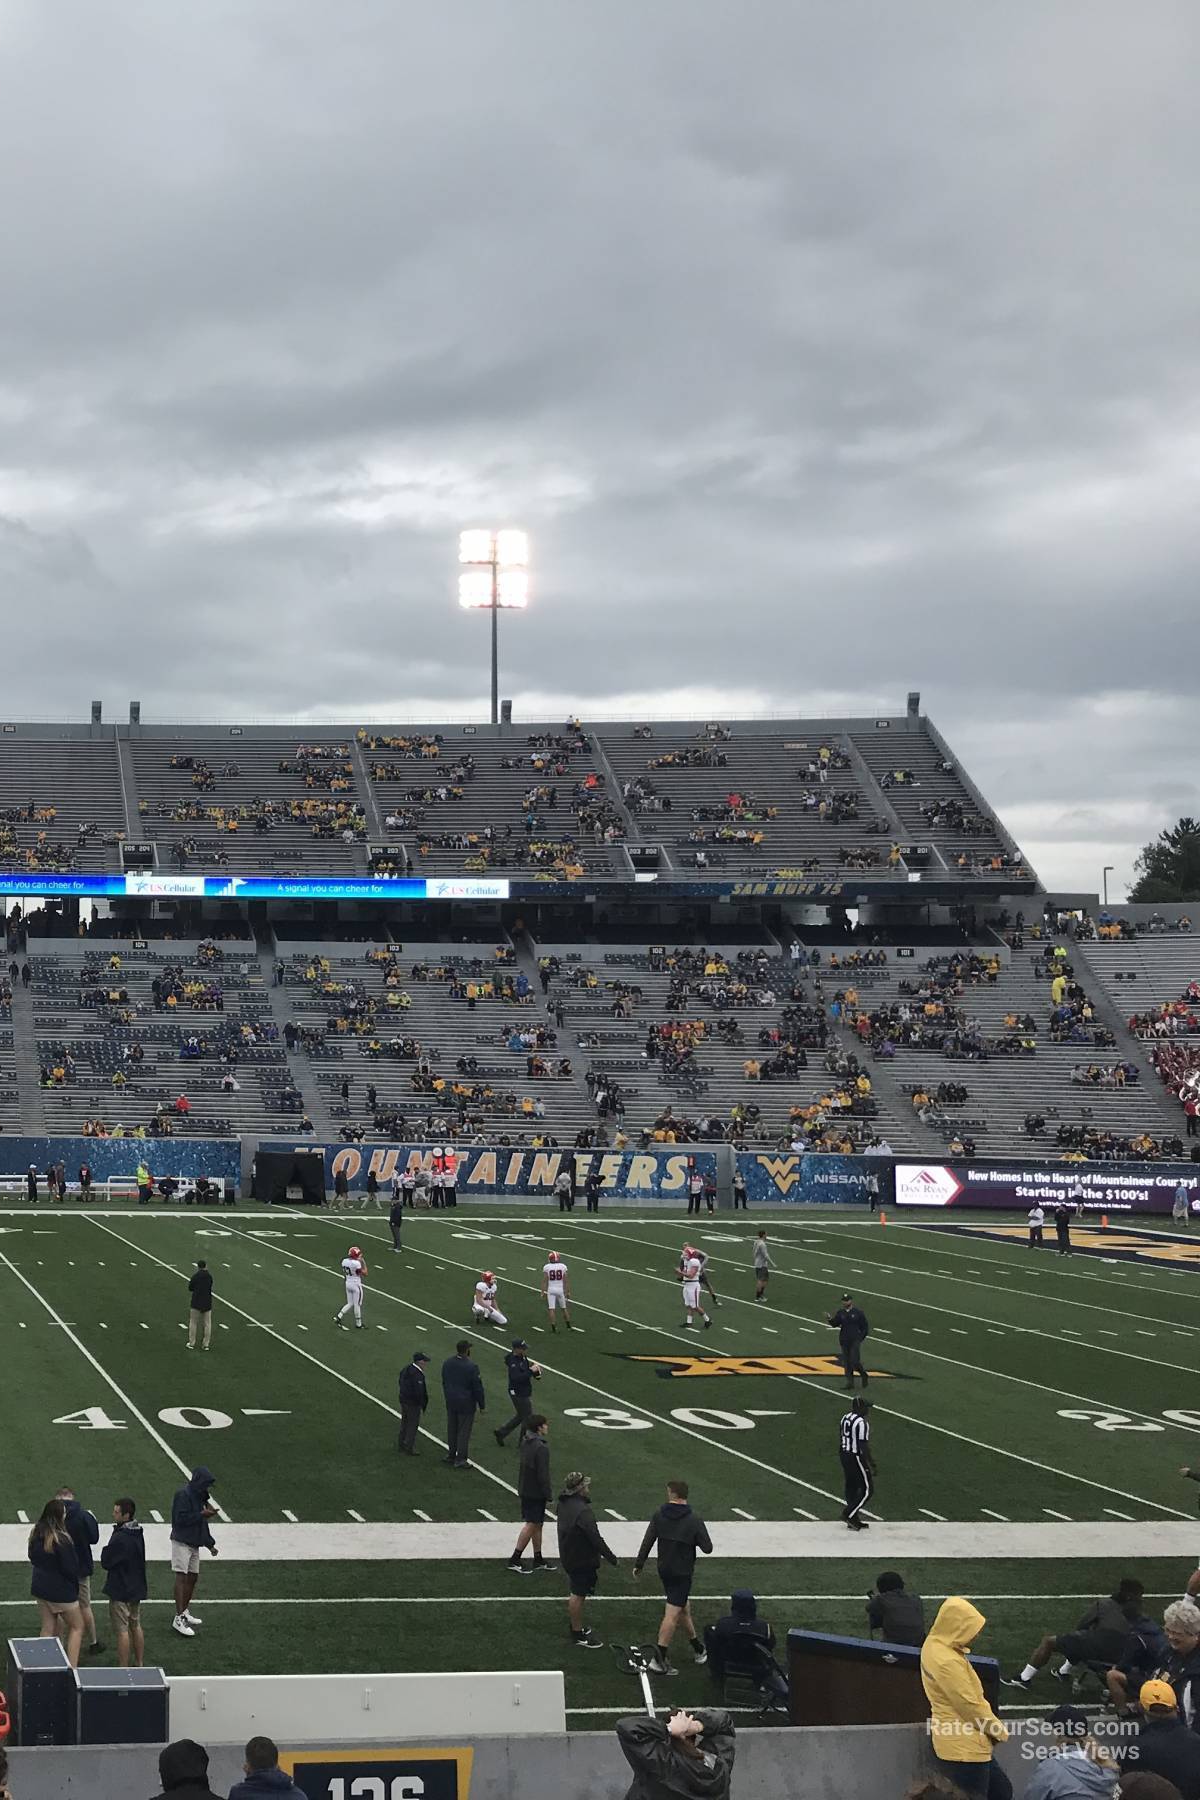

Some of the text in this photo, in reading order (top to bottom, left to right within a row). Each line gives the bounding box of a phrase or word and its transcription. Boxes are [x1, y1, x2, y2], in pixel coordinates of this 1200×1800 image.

[15, 883, 31, 891] you
[48, 881, 72, 890] cheer
[164, 884, 195, 892] Cellular
[285, 884, 310, 893] signal
[311, 886, 327, 894] you
[345, 884, 370, 893] cheer
[465, 886, 500, 895] Cellular
[732, 884, 766, 894] SAM
[774, 884, 816, 894] HUFF
[814, 1174, 870, 1184] NISSAN
[968, 1170, 988, 1180] New
[990, 1171, 1022, 1182] Homes
[1023, 1172, 1033, 1182] in
[1034, 1173, 1050, 1182] the
[1052, 1173, 1079, 1184] Heart
[1081, 1174, 1092, 1184] of
[1093, 1174, 1154, 1186] Mountaineer
[1016, 1186, 1065, 1199] Starting
[1083, 1188, 1103, 1198] the
[1106, 1189, 1148, 1200] $100's!
[52, 1407, 233, 1429] 40
[564, 1408, 756, 1430] 30
